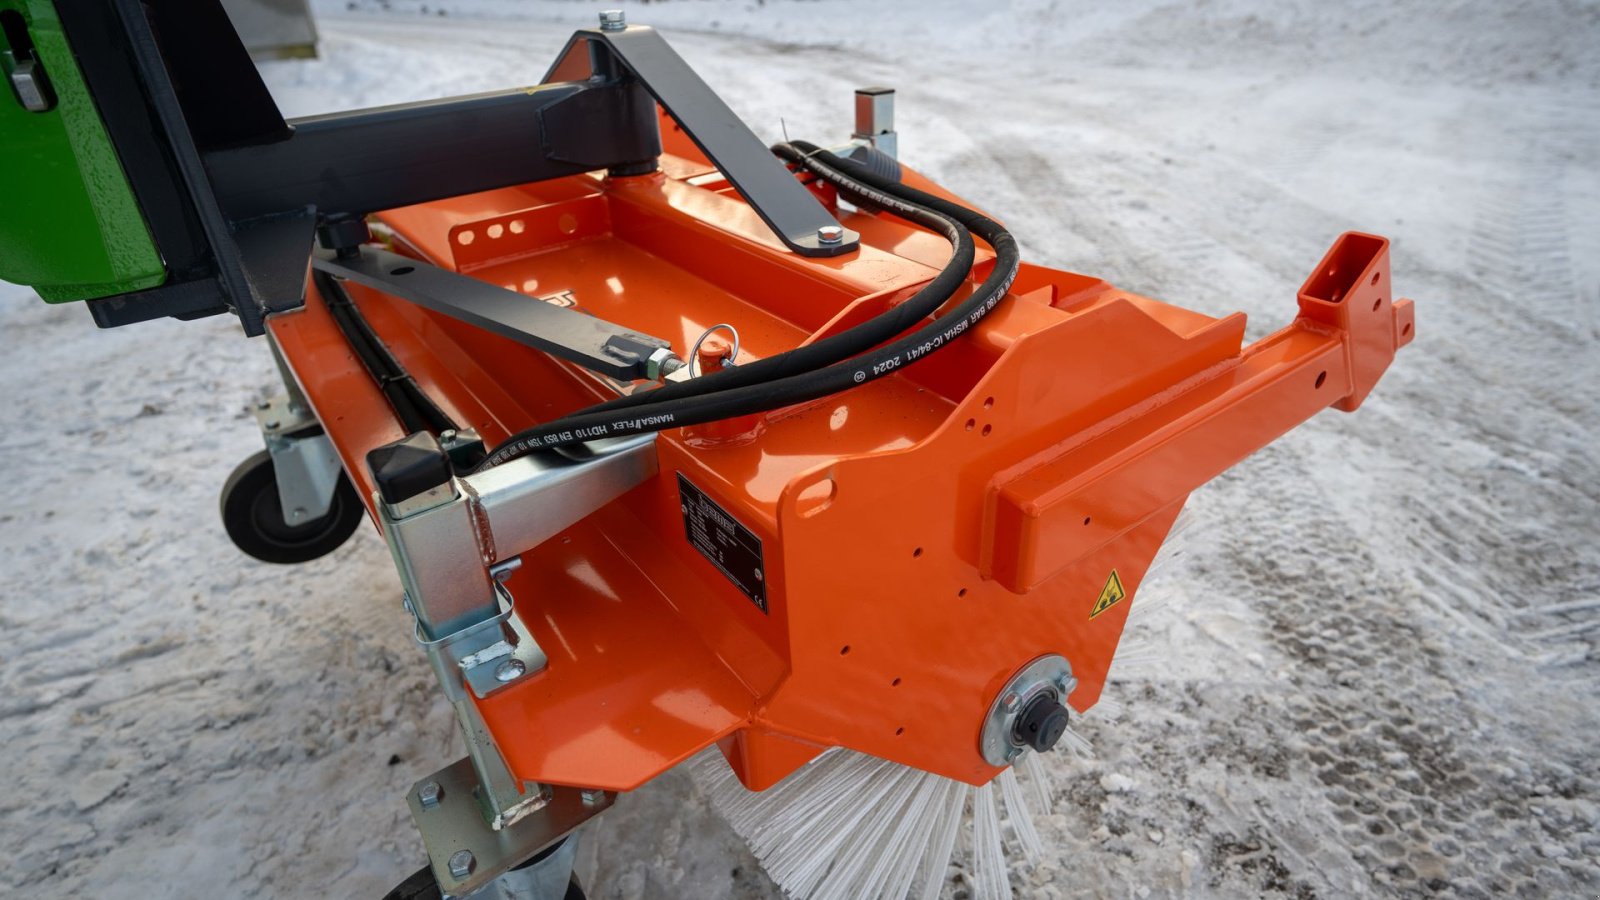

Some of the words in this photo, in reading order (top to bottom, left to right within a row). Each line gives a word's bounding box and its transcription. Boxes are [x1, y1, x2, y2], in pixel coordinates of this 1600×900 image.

[970, 309, 985, 324] BAR
[944, 320, 969, 341] MSHA
[906, 338, 944, 361] IC-84/41
[873, 356, 901, 375] 2Q24
[544, 434, 559, 444] 853
[558, 431, 573, 442] EN
[575, 425, 608, 439] HD110
[518, 441, 527, 451] 10
[527, 436, 543, 448] 1SN
